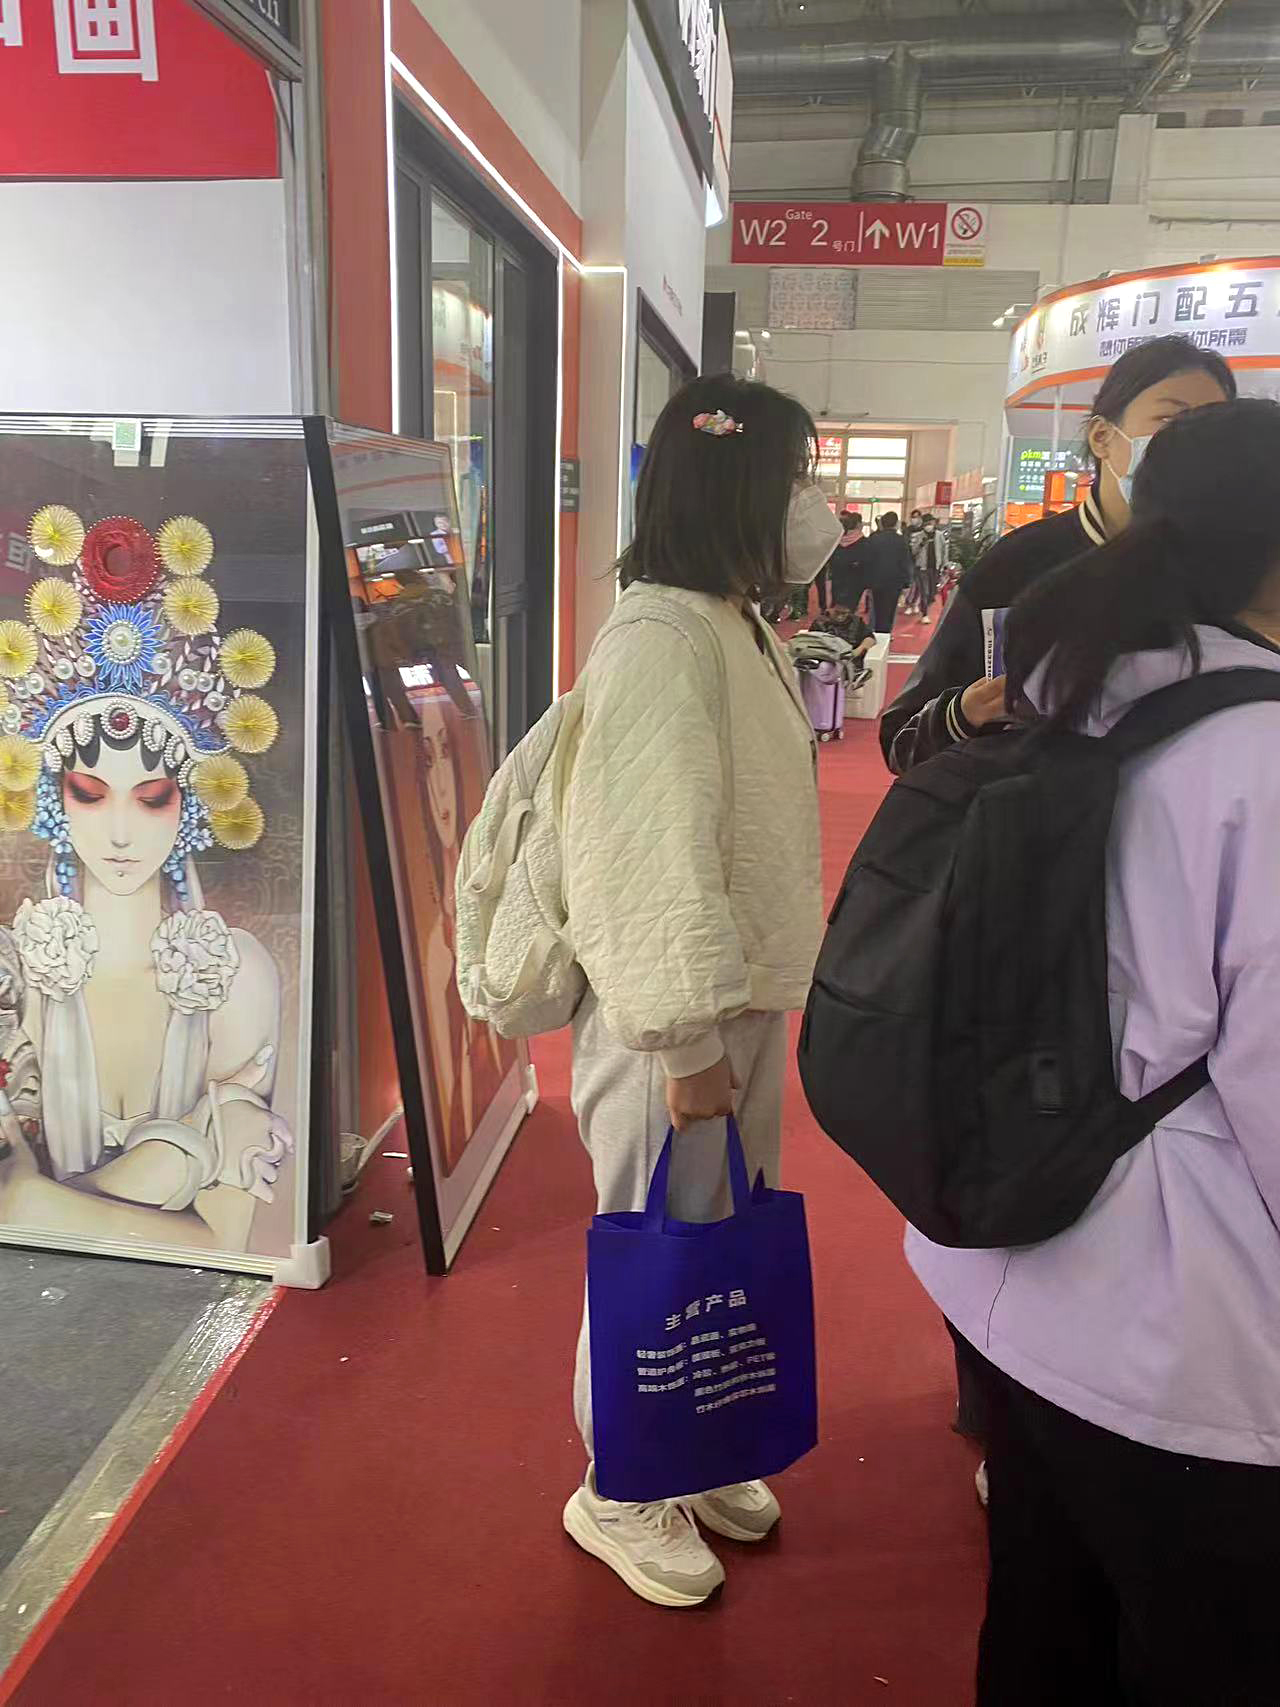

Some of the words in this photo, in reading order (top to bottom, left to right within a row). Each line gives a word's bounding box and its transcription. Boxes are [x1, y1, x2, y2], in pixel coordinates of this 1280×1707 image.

[785, 208, 813, 221] Gate
[739, 219, 788, 246] W2
[809, 220, 829, 247] 2
[895, 222, 941, 249] W1
[1070, 281, 1280, 336] 成辉门配五
